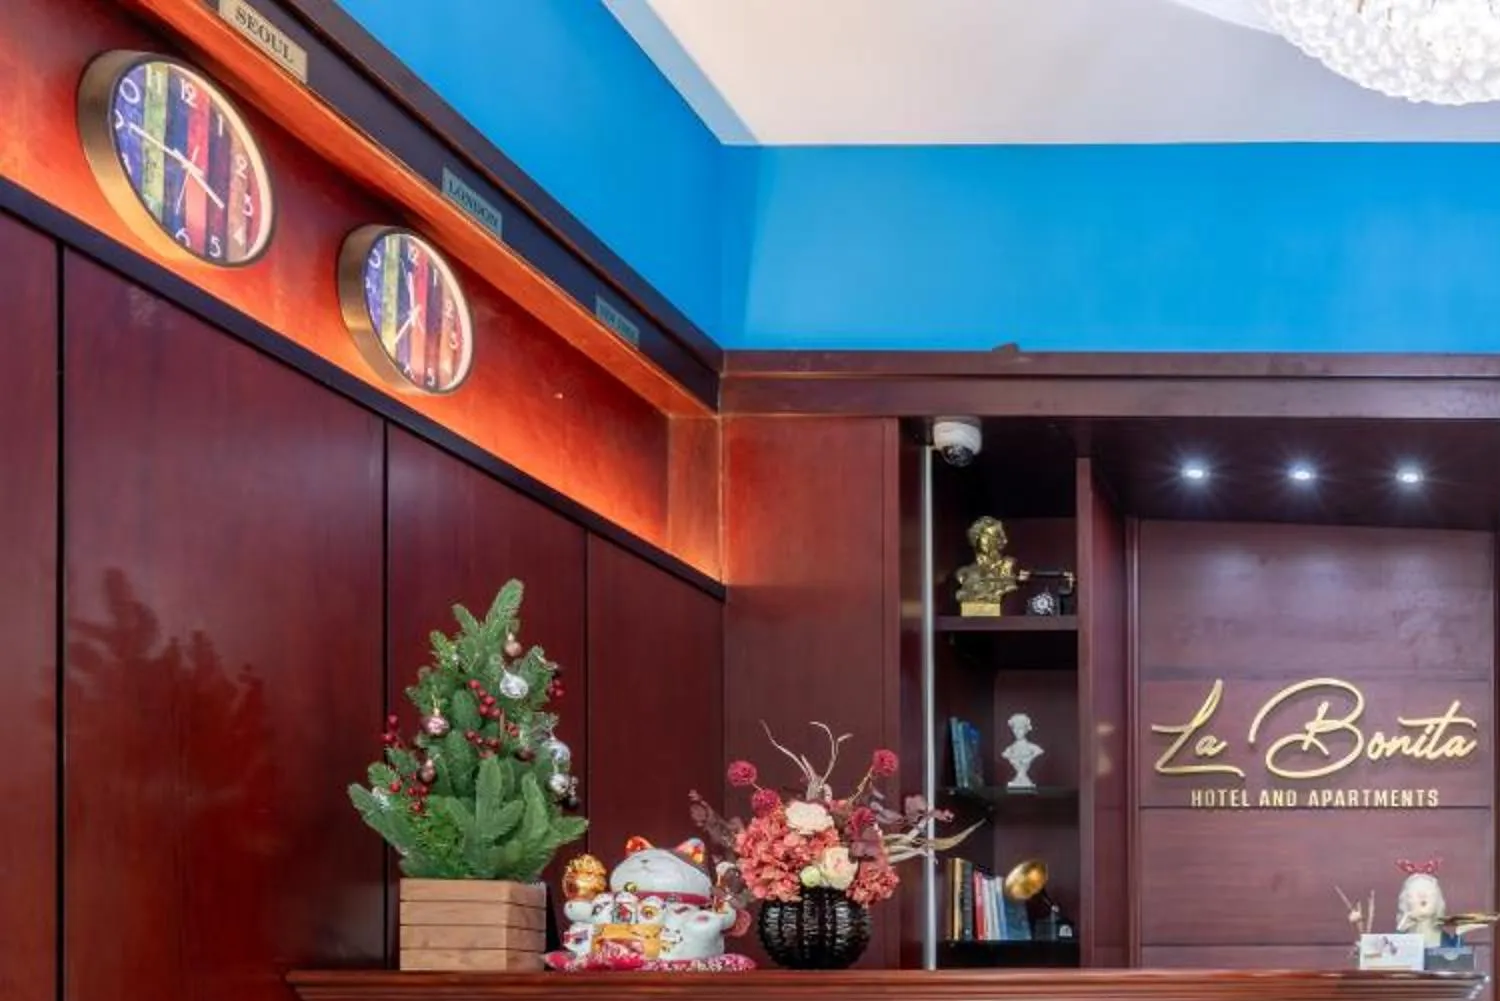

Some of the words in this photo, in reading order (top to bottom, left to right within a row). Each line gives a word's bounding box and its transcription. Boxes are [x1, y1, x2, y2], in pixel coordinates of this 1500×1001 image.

[235, 5, 295, 63] SEOUL
[180, 78, 199, 109] 12
[448, 179, 499, 230] LONDON
[209, 234, 223, 258] 5
[1151, 679, 1246, 778] La
[1248, 677, 1477, 779] Bonita
[1190, 788, 1250, 808] HOTEL
[1258, 788, 1298, 808] AND
[1308, 788, 1440, 808] APARTMENTS
